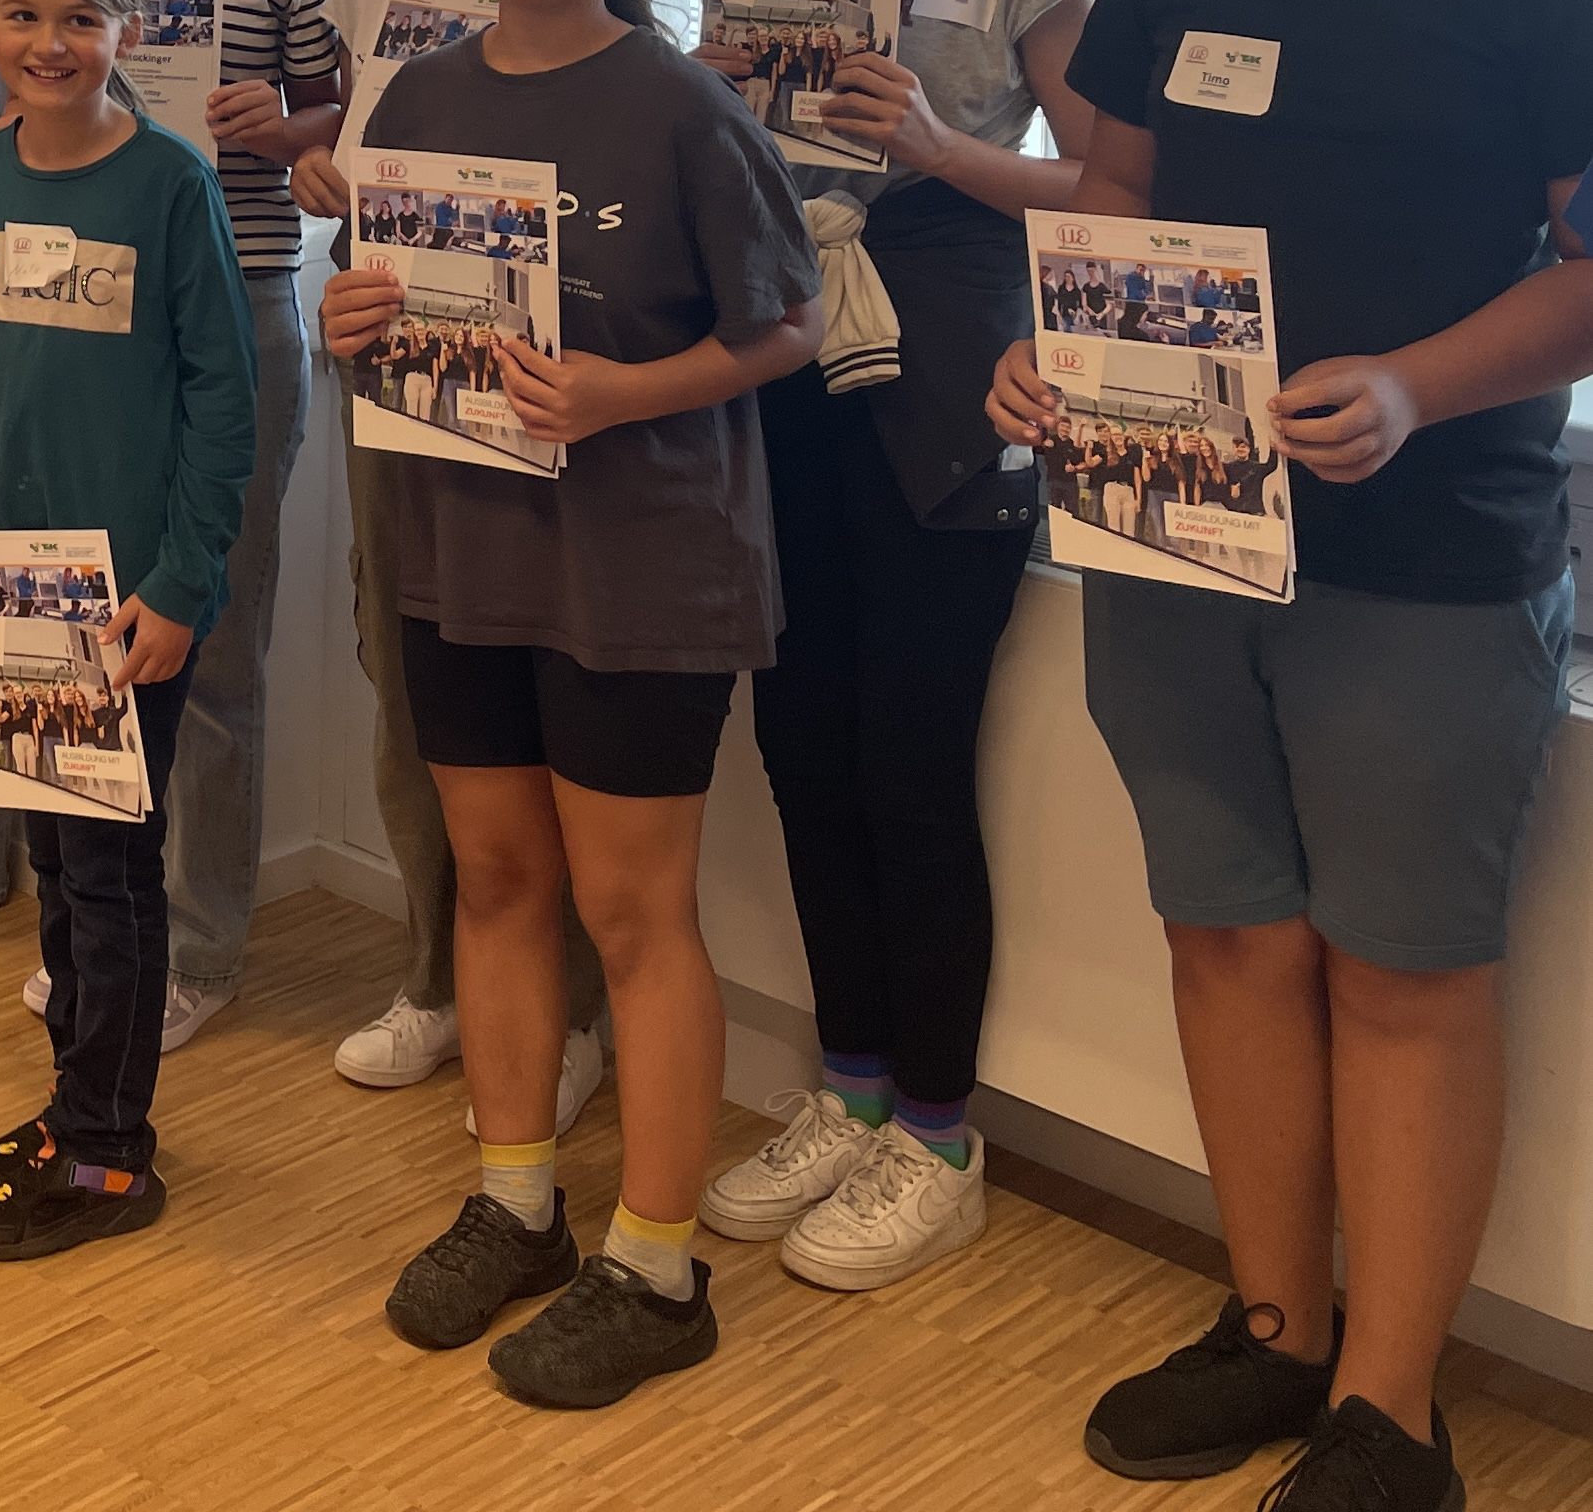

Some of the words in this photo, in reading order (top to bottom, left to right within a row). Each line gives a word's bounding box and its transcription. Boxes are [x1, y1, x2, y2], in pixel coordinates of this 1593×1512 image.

[1202, 72, 1230, 86] Timo
[465, 407, 506, 420] ZUKUNFT
[1174, 509, 1240, 528] AUSBILDUNG
[1243, 520, 1261, 530] MIT
[1174, 521, 1224, 536] ZUKUNFT
